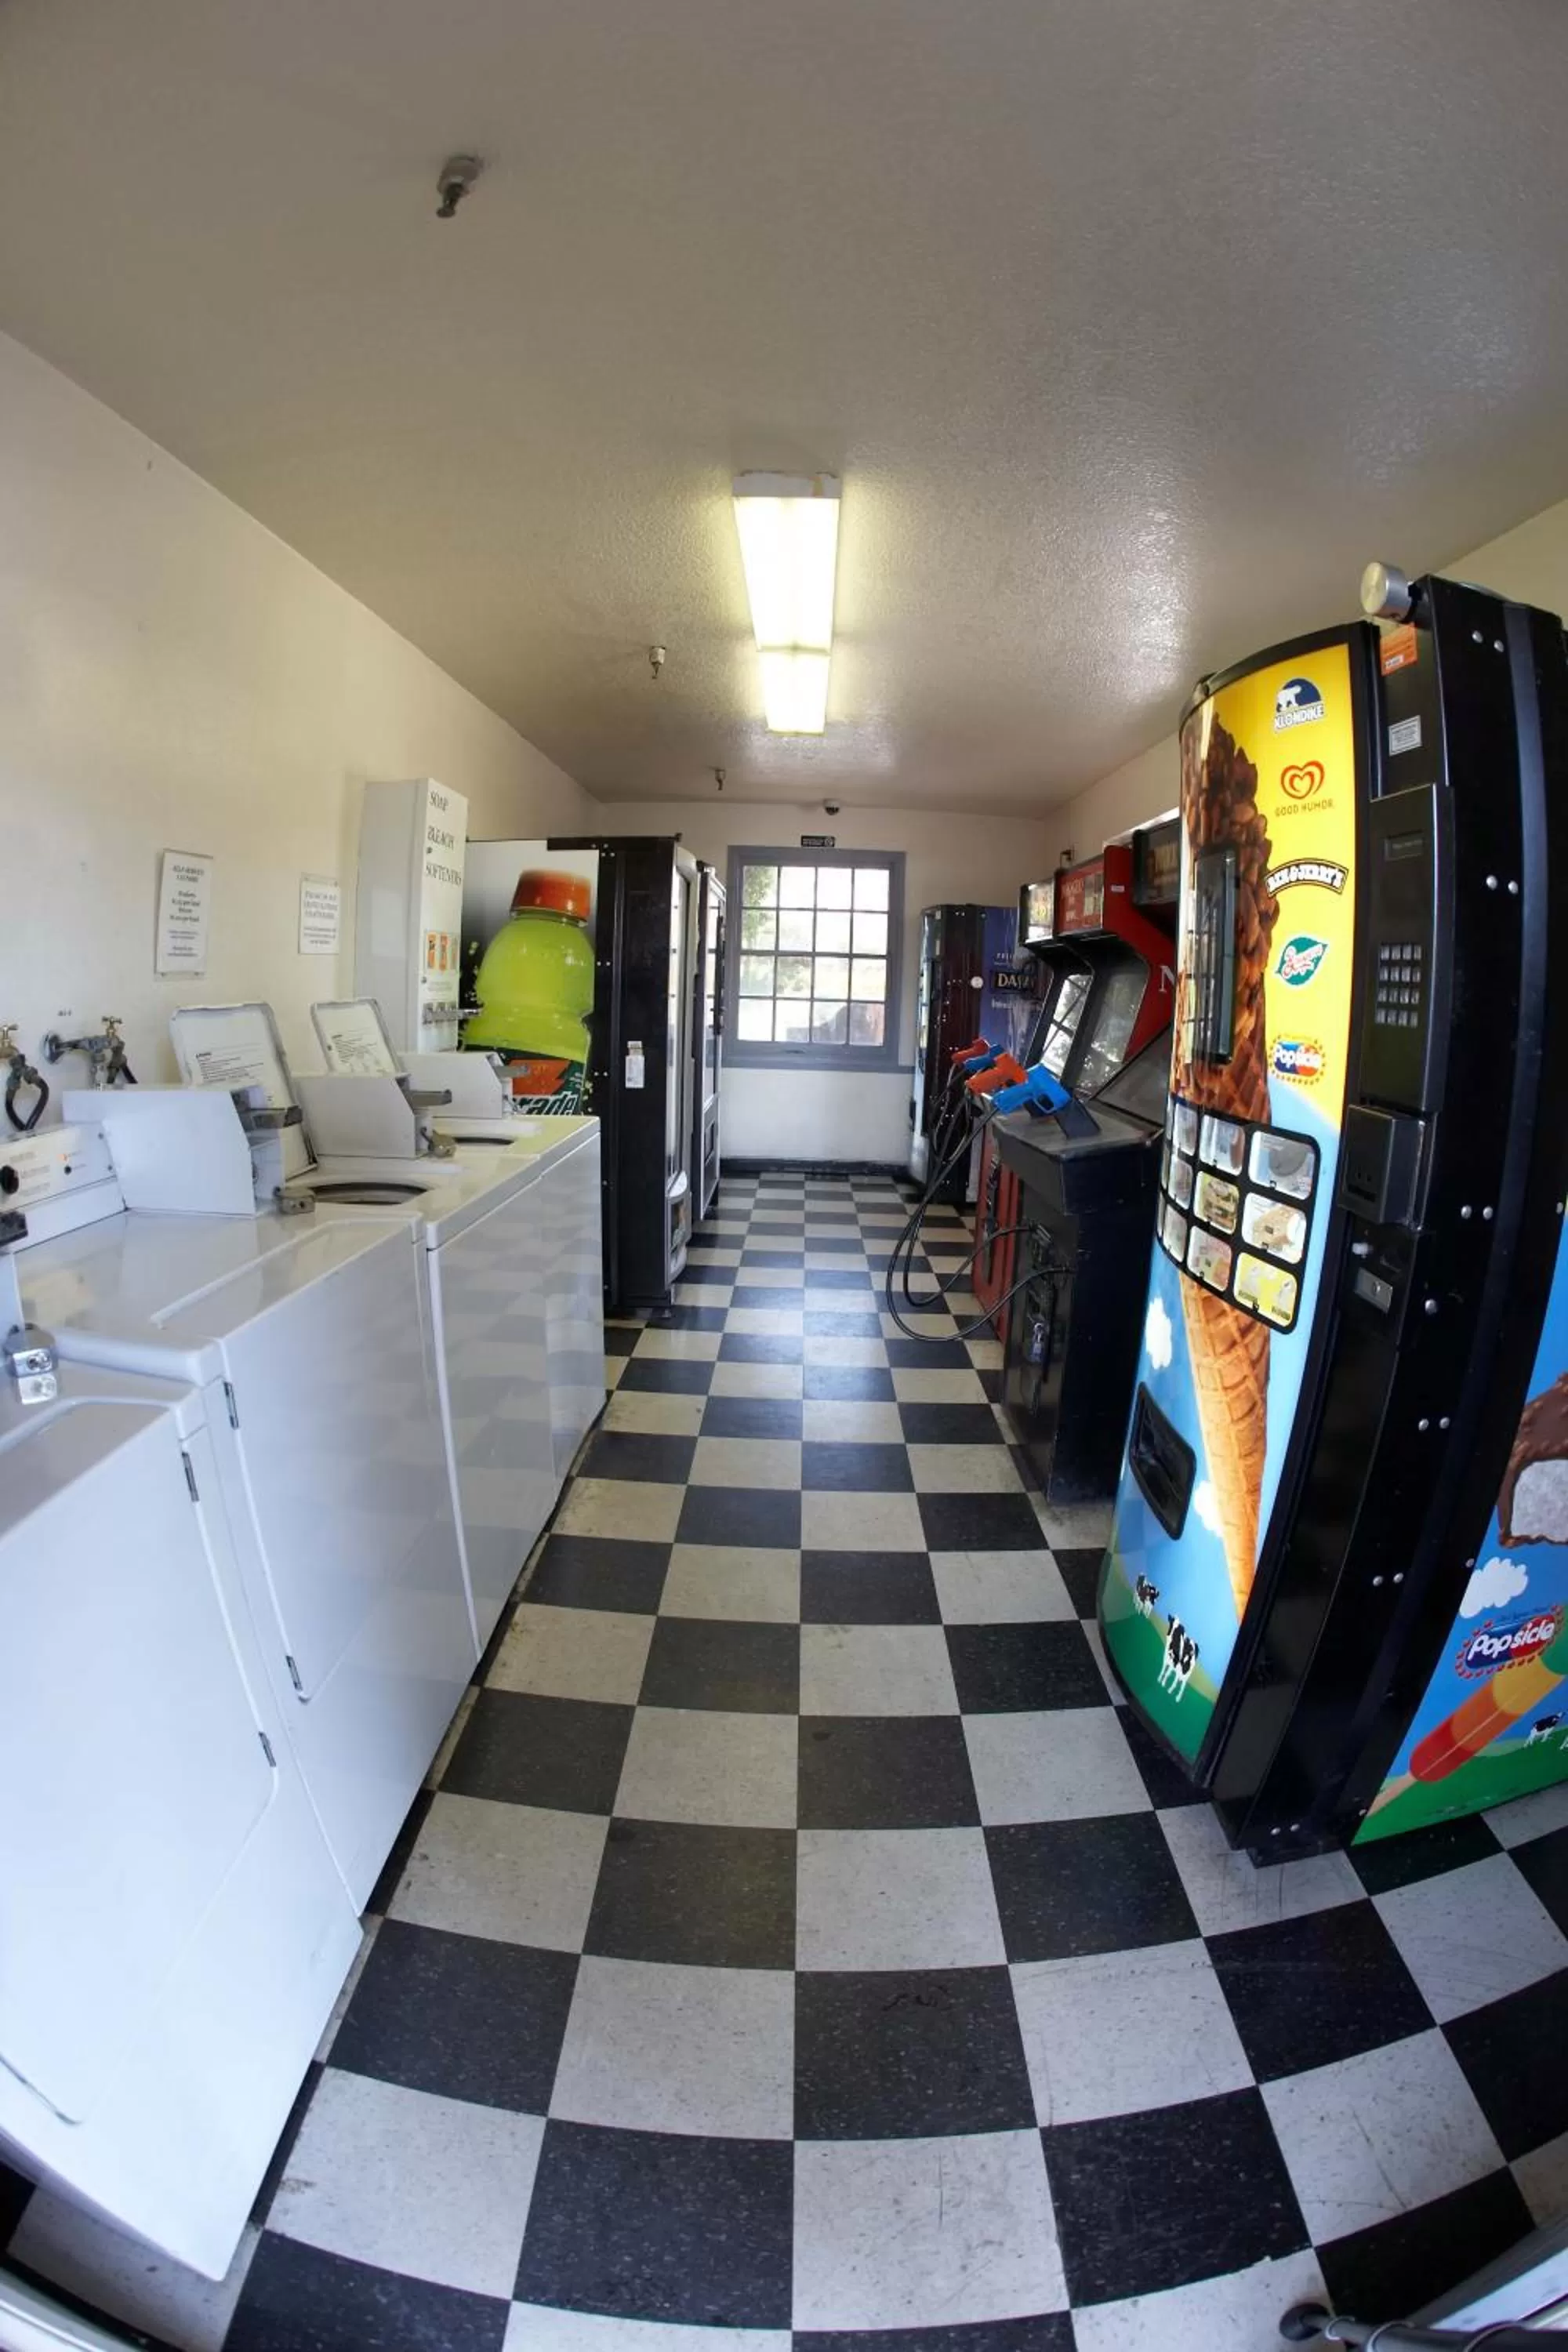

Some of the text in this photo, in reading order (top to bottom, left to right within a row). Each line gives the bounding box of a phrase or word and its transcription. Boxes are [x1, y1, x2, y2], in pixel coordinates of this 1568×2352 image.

[429, 790, 449, 812] SOAP
[1275, 798, 1334, 818] GOOD HUMOR
[427, 826, 455, 851] BLEACH
[1467, 1618, 1555, 1661] Popsicle
